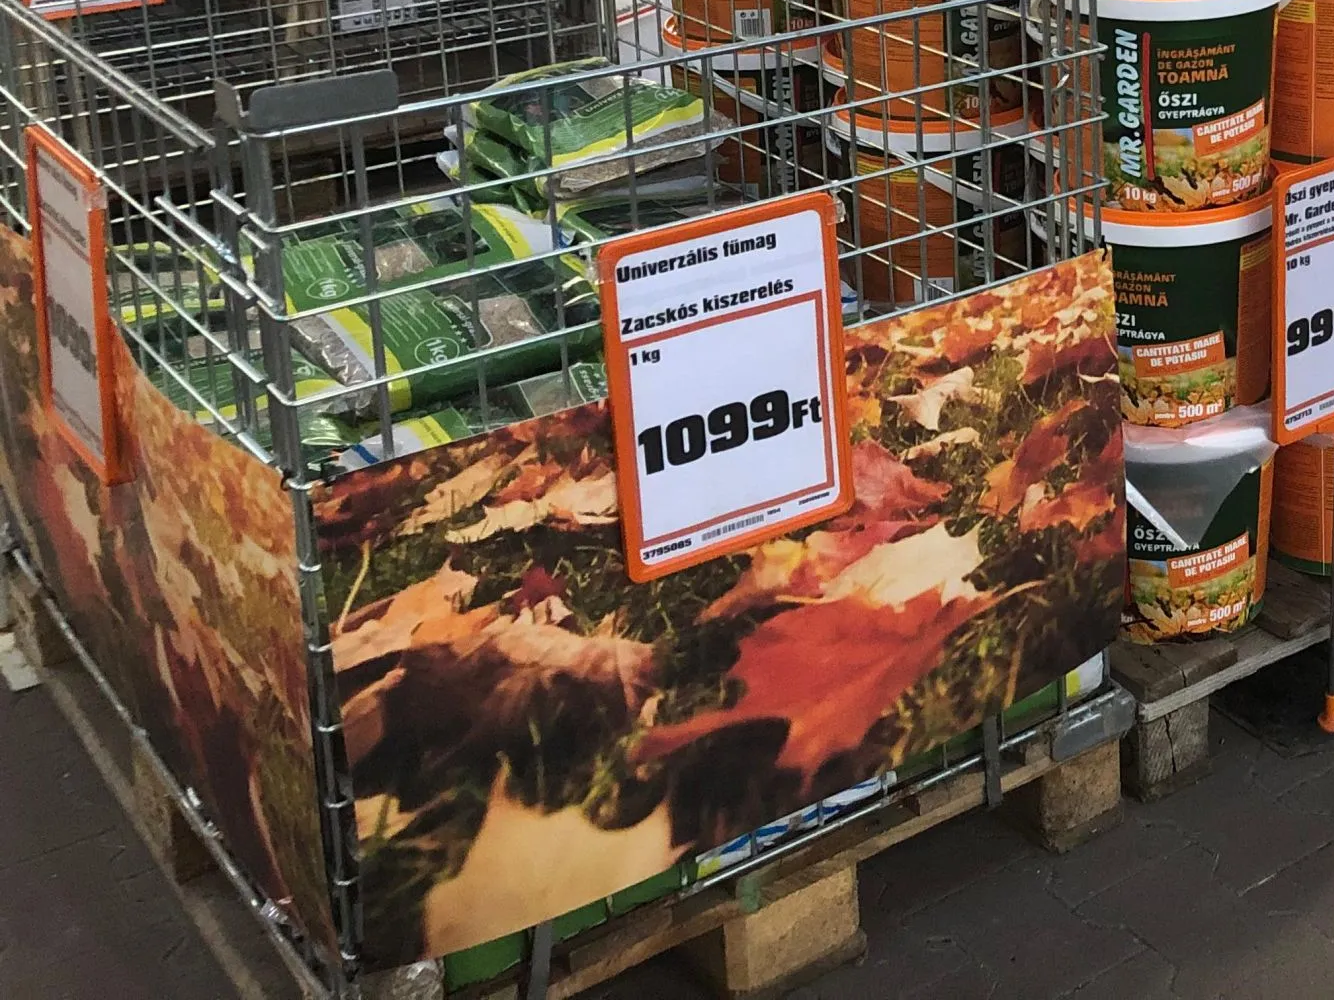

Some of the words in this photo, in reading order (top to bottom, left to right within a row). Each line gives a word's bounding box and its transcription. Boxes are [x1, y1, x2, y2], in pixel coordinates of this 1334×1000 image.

[1158, 61, 1172, 70] DE
[1176, 59, 1214, 69] GAZON
[1157, 64, 1229, 85] TOAMNĂ
[1115, 28, 1141, 178] MR.GARDEN
[1158, 91, 1198, 107] ŐSZI
[1158, 106, 1225, 120] GYEPTRÁGYA
[1197, 115, 1245, 137] CANTITATE
[1210, 133, 1223, 144] DE
[1232, 178, 1250, 191] 500
[1124, 187, 1140, 200] 10
[1143, 190, 1156, 203] kg
[615, 244, 718, 284] Univerzális
[722, 232, 777, 258] fűmag
[1287, 259, 1297, 270] 10
[1300, 255, 1310, 266] kg
[1115, 283, 1151, 292] GAZON
[621, 302, 698, 336] Zacskós
[703, 277, 794, 315] kiszerelés
[1136, 341, 1191, 357] CANTITATE
[1194, 334, 1221, 350] MARE
[629, 352, 638, 366] 1
[642, 348, 661, 365] kg
[1150, 357, 1163, 368] DE
[1165, 349, 1207, 366] POTASIU
[1178, 405, 1203, 418] 500
[637, 389, 823, 476] 1099Ft
[1134, 525, 1169, 541] ŐSZ
[1171, 549, 1223, 570] CANTITATE
[1184, 568, 1198, 577] DE
[1199, 552, 1236, 573] POTASIU
[1210, 606, 1231, 621] 500
